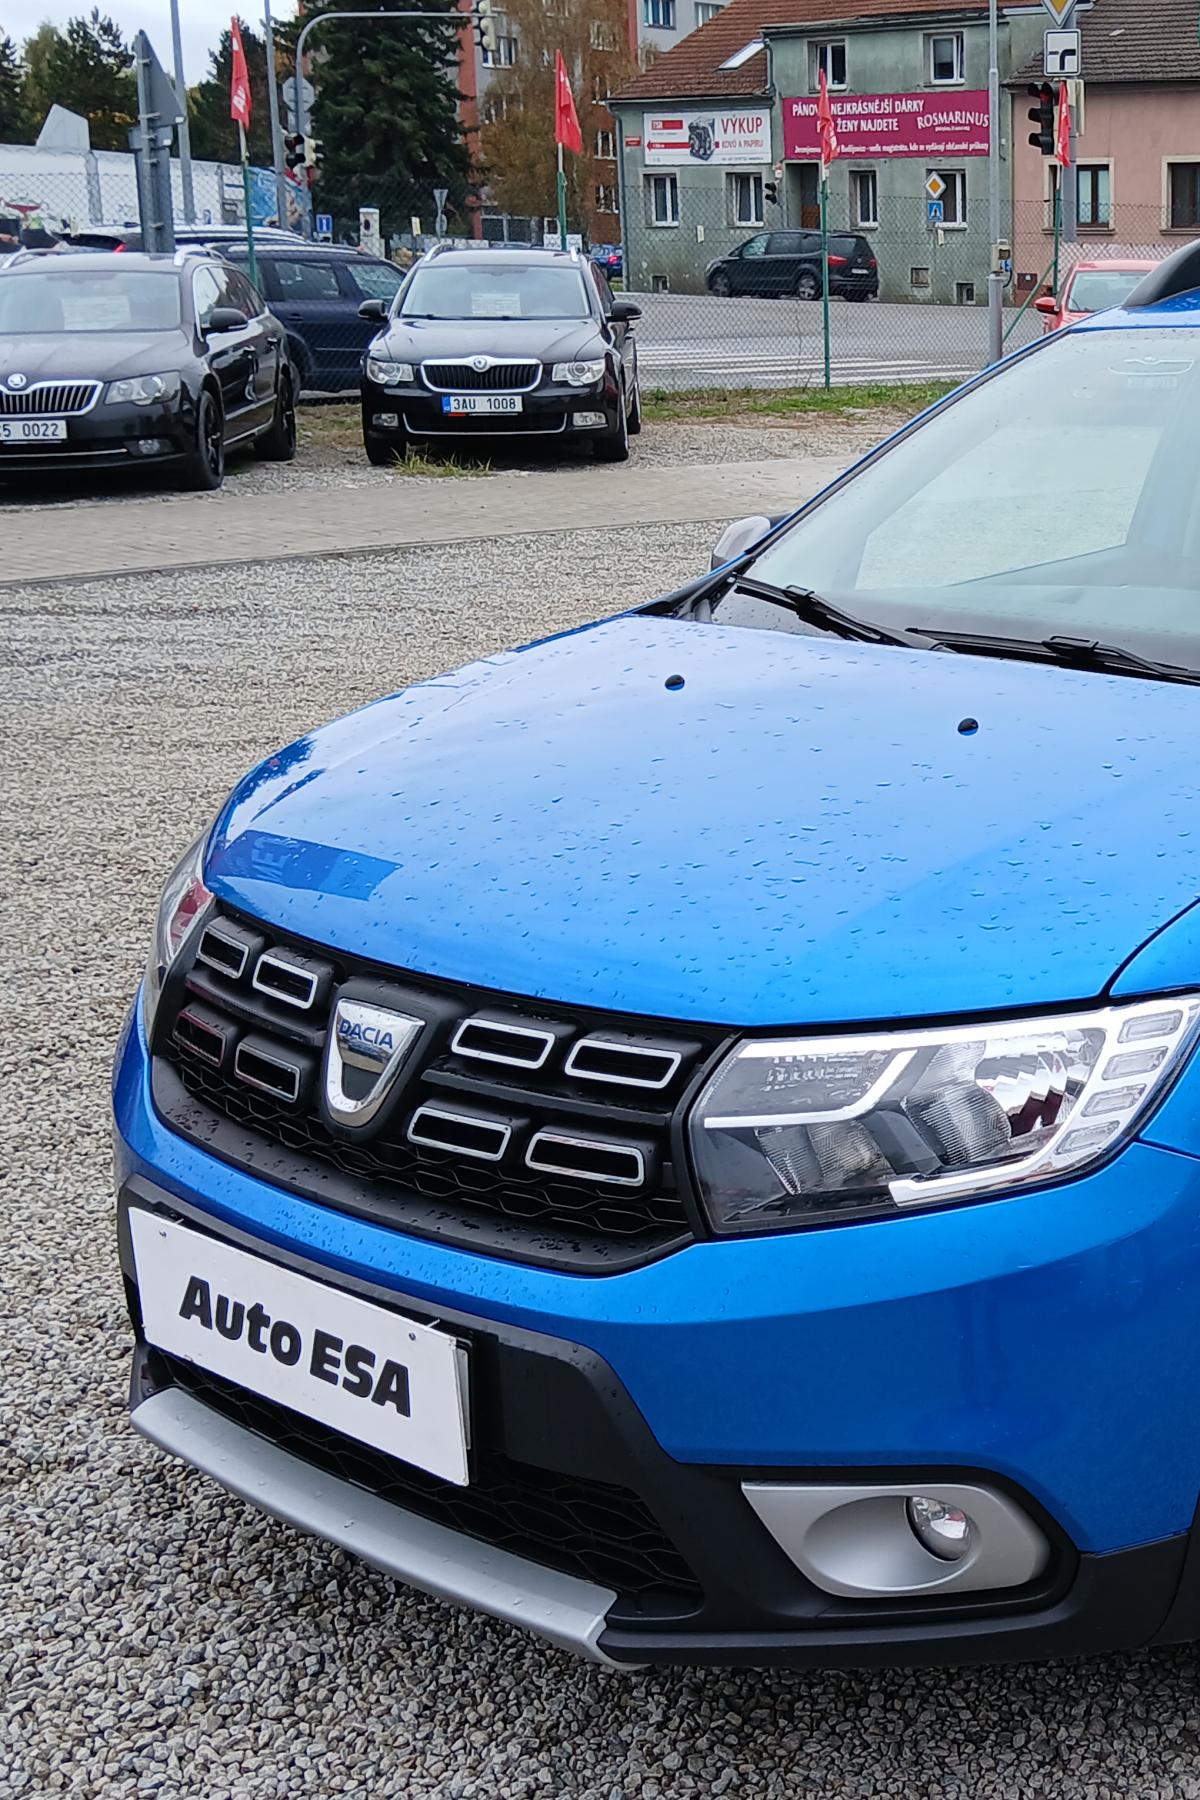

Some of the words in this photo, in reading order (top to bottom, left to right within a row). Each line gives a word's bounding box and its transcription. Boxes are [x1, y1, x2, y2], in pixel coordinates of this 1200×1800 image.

[792, 101, 820, 117] PÁNOV
[830, 98, 893, 116] NEJKRÁSNĚJŠÍ
[894, 98, 925, 114] DÁRKY
[720, 114, 763, 135] VÝKUP
[836, 117, 859, 133] ŽENY
[860, 118, 899, 132] NAJDETE
[916, 110, 990, 130] ROSMARINUS
[453, 398, 476, 410] 3AU
[486, 398, 517, 410] 1008
[0, 423, 12, 438] 5
[22, 423, 60, 438] 0022
[339, 1018, 394, 1050] DACIA
[178, 1275, 301, 1366] Auto
[309, 1327, 411, 1419] ESA
